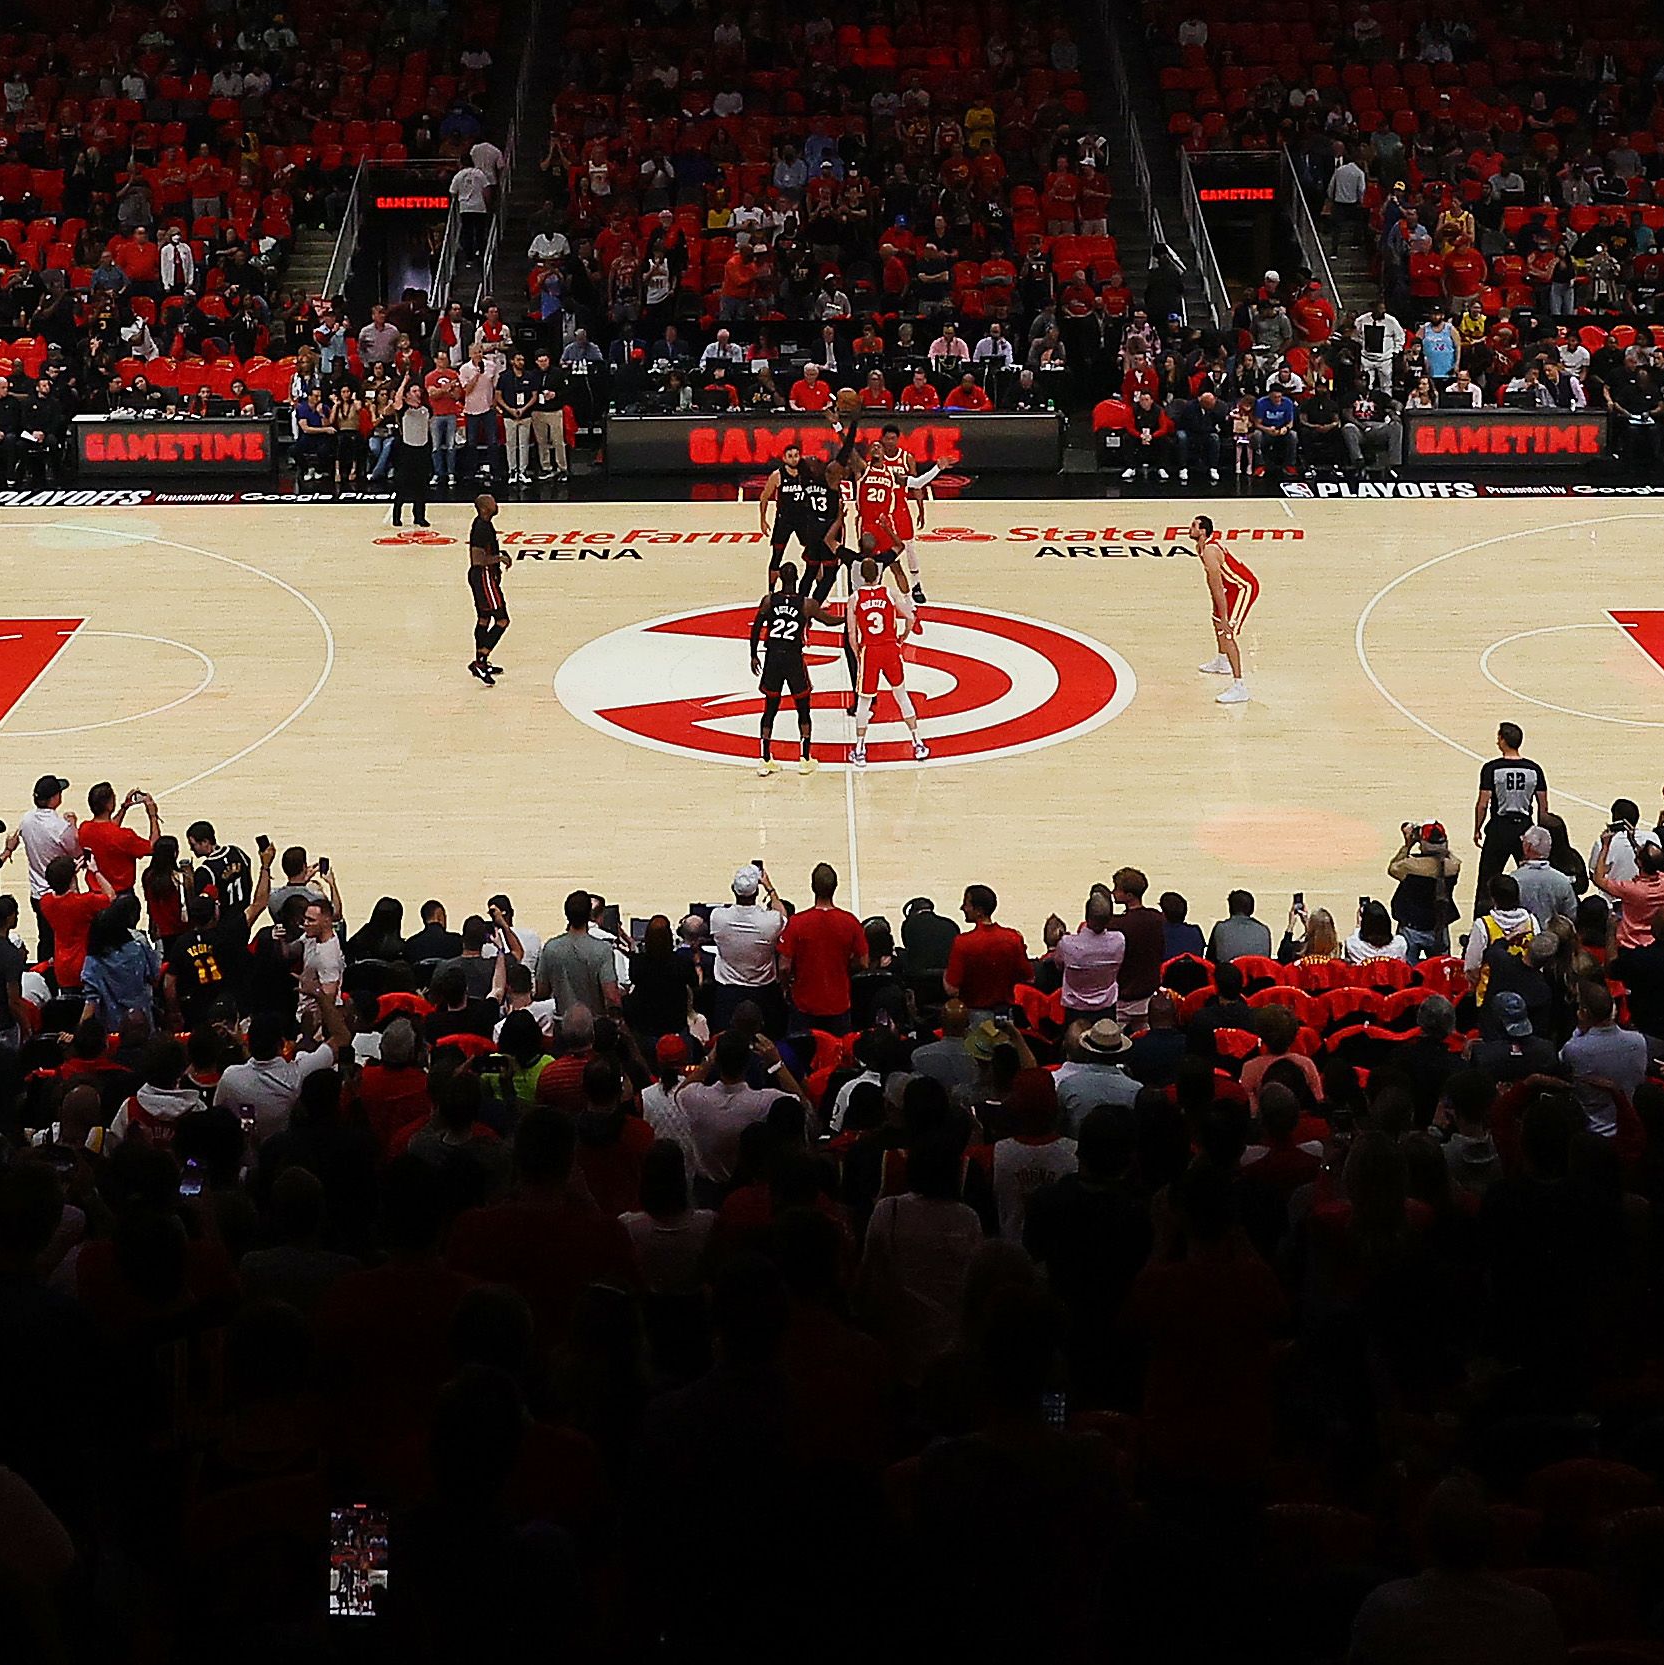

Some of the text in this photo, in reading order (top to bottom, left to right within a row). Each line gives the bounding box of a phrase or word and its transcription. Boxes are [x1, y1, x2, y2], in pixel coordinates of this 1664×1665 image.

[376, 196, 450, 209] GAMETIME
[1199, 187, 1274, 202] GAMETIME
[84, 432, 266, 462] GAMETIME
[1415, 424, 1599, 455] GAMETIME
[239, 492, 333, 504] Google
[337, 492, 397, 501] Pixel
[866, 487, 886, 503] 20
[1316, 482, 1480, 498] PLAYOFFS
[810, 496, 828, 512] 13
[499, 528, 764, 545] tate Farm
[1005, 526, 1304, 543] State Frm
[503, 549, 645, 561] RENA
[1034, 545, 1198, 559] ARENA
[769, 619, 799, 640] 22
[866, 611, 885, 635] 3
[1505, 772, 1526, 791] 62
[226, 877, 243, 906] 11
